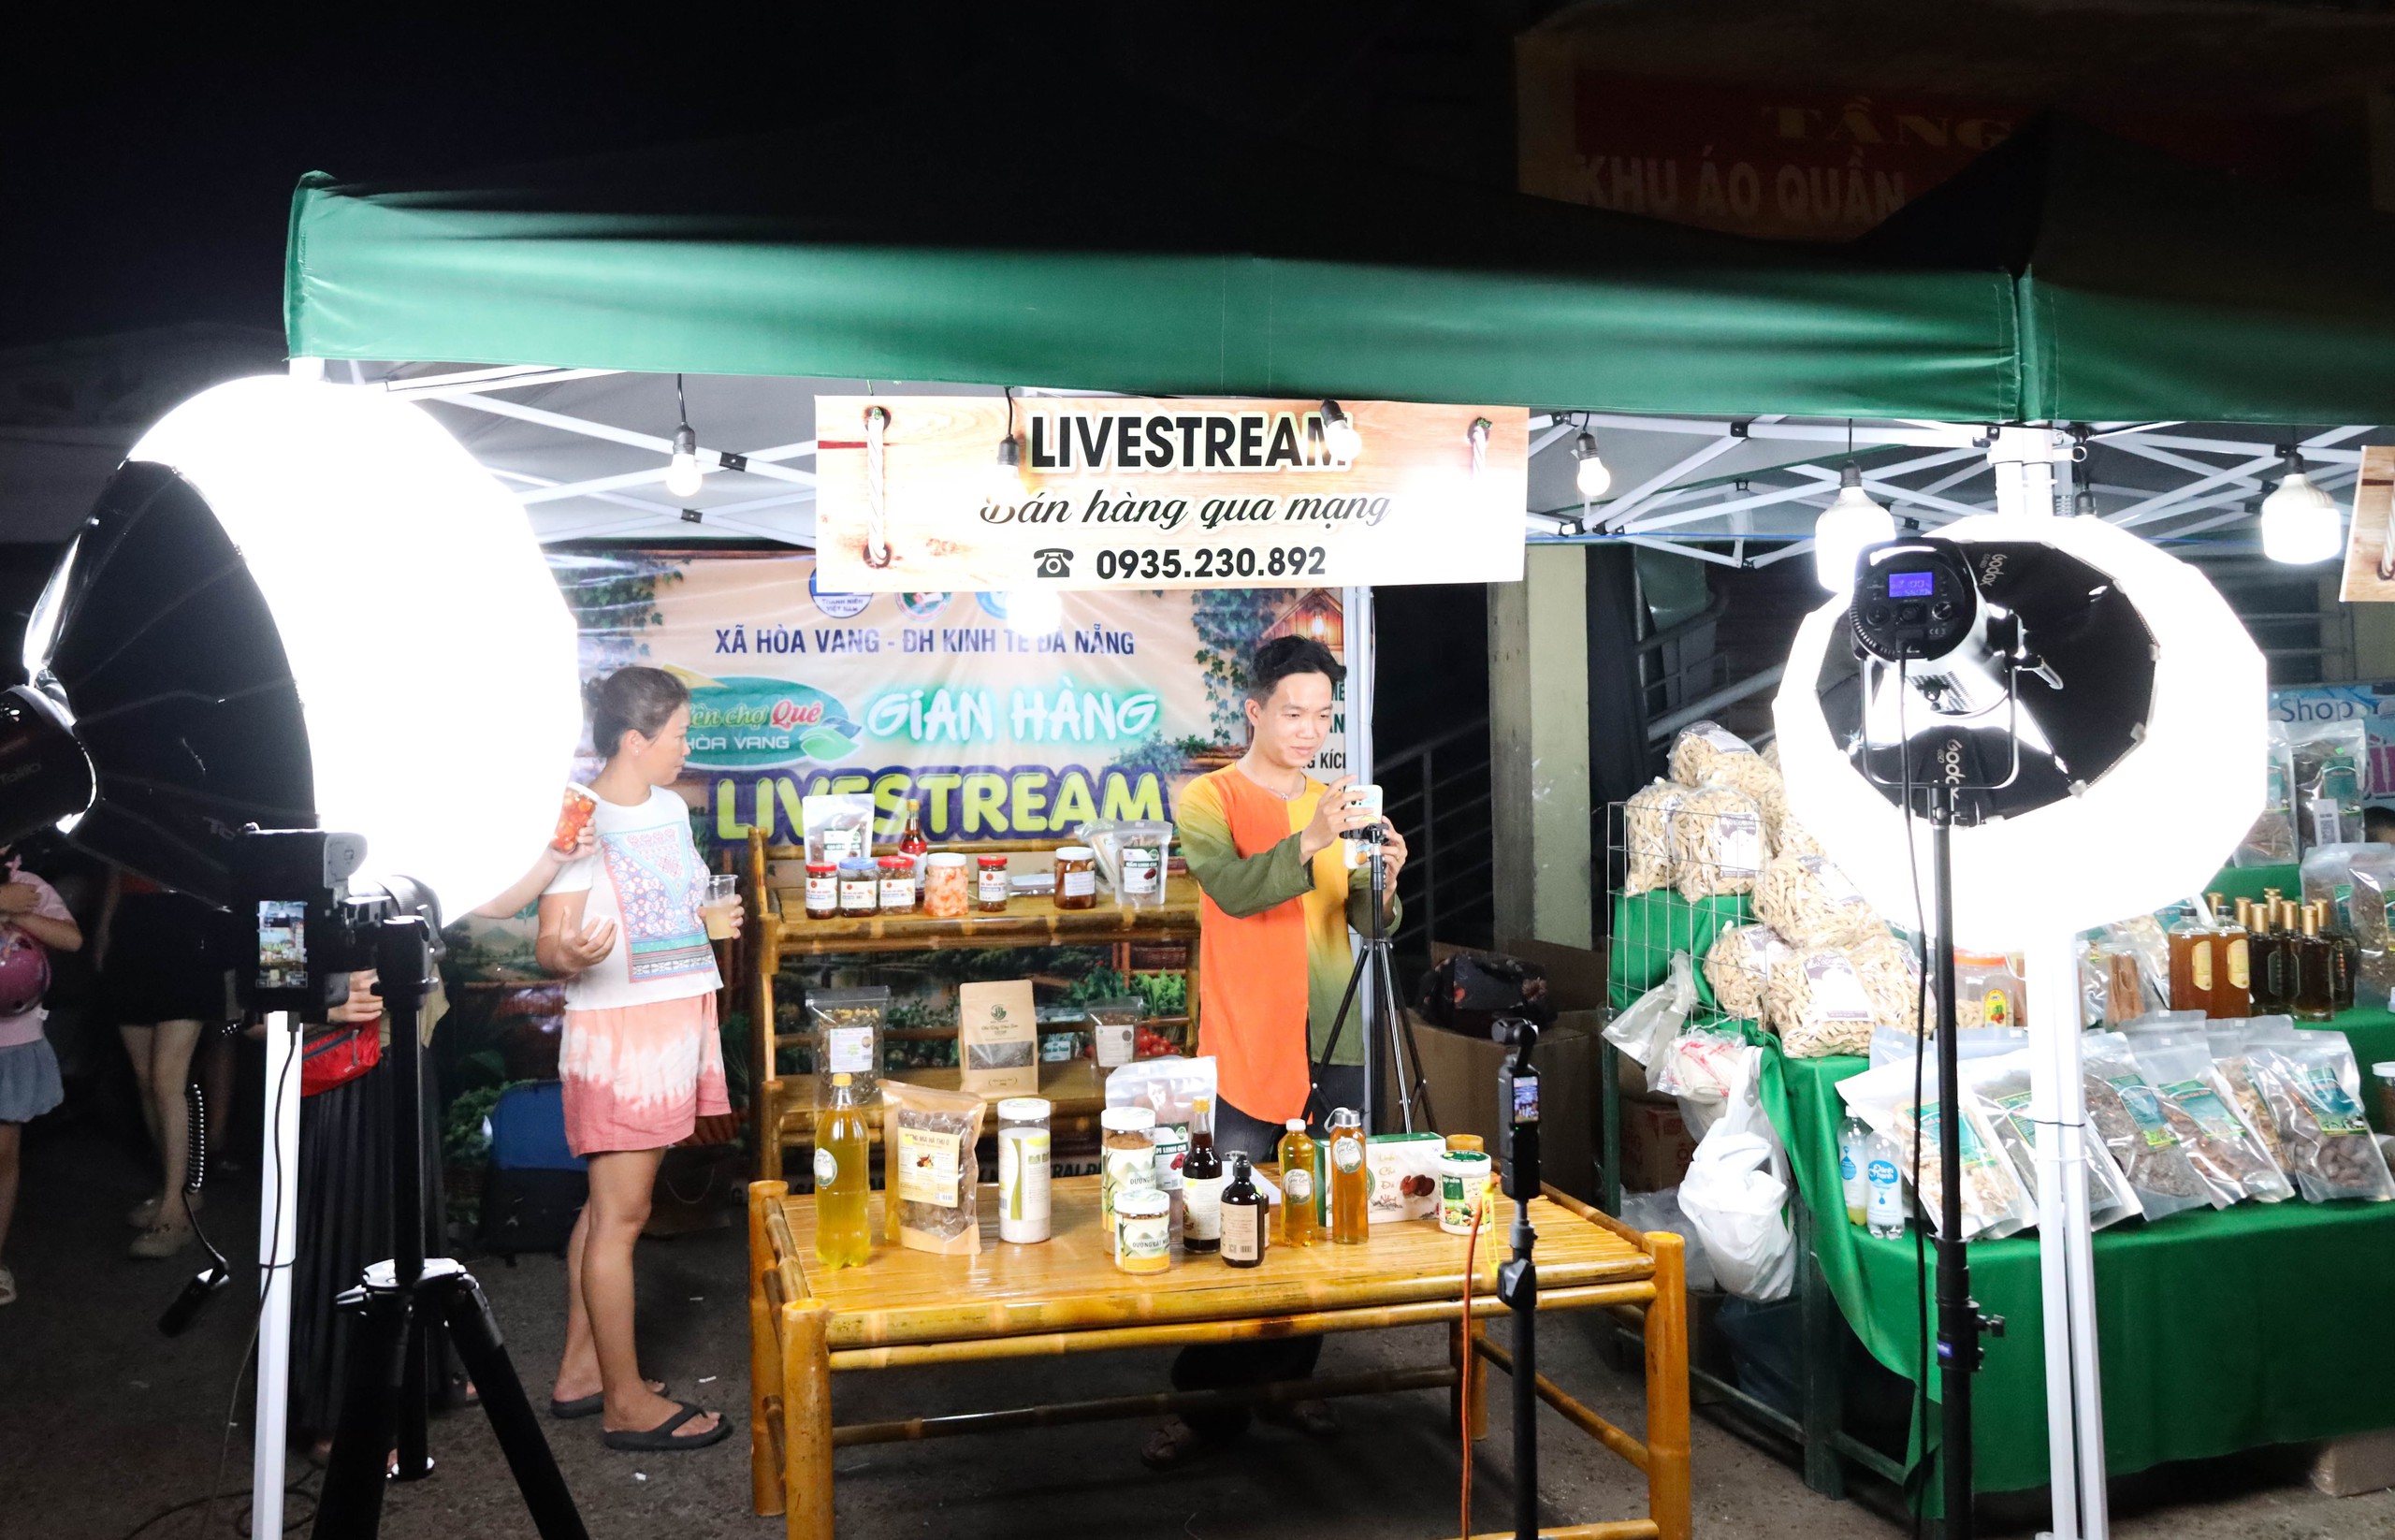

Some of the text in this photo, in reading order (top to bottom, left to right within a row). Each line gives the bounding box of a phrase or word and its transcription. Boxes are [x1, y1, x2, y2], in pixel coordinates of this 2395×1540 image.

[1575, 153, 1678, 211] KHU
[1695, 144, 1761, 218] ÁO
[1081, 488, 1189, 530] hàng
[1199, 499, 1277, 530] qua
[1284, 493, 1391, 530] mạng
[1096, 546, 1326, 580] 0935.230.892
[1979, 553, 2008, 588] Godox
[715, 624, 748, 654] XÃ
[756, 624, 806, 654] HÒA
[815, 628, 880, 654] VANG
[903, 629, 935, 653] ĐH
[943, 628, 996, 653] KINH
[771, 700, 823, 731] Quê
[1010, 676, 1157, 742] HÀNG
[2278, 699, 2354, 723] Shop
[734, 735, 790, 749] VANG
